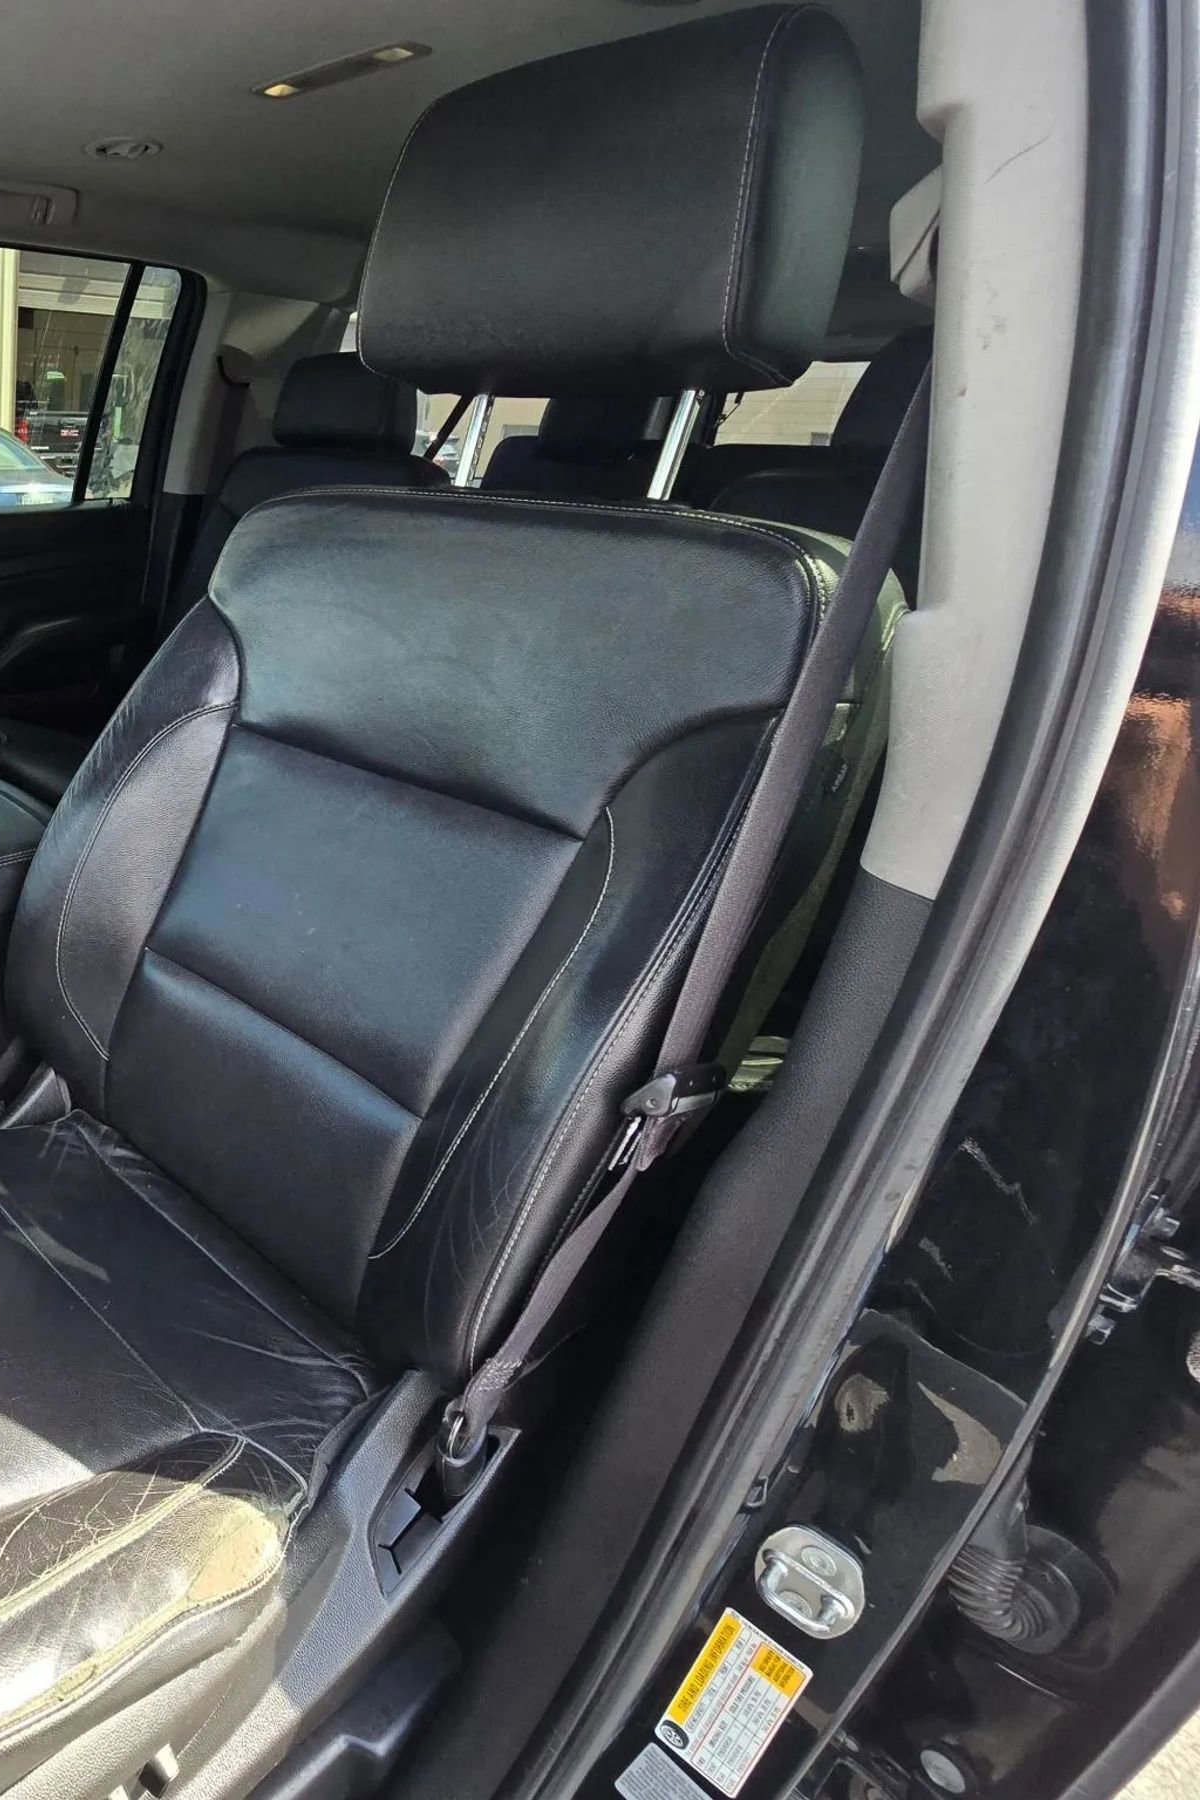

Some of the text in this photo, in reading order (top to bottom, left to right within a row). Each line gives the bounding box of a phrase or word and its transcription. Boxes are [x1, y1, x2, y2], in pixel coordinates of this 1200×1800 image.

[706, 1622, 736, 1664] INFORMATION
[692, 1657, 715, 1687] LOADING
[685, 1681, 700, 1700] AND
[677, 1695, 693, 1714] TIRE
